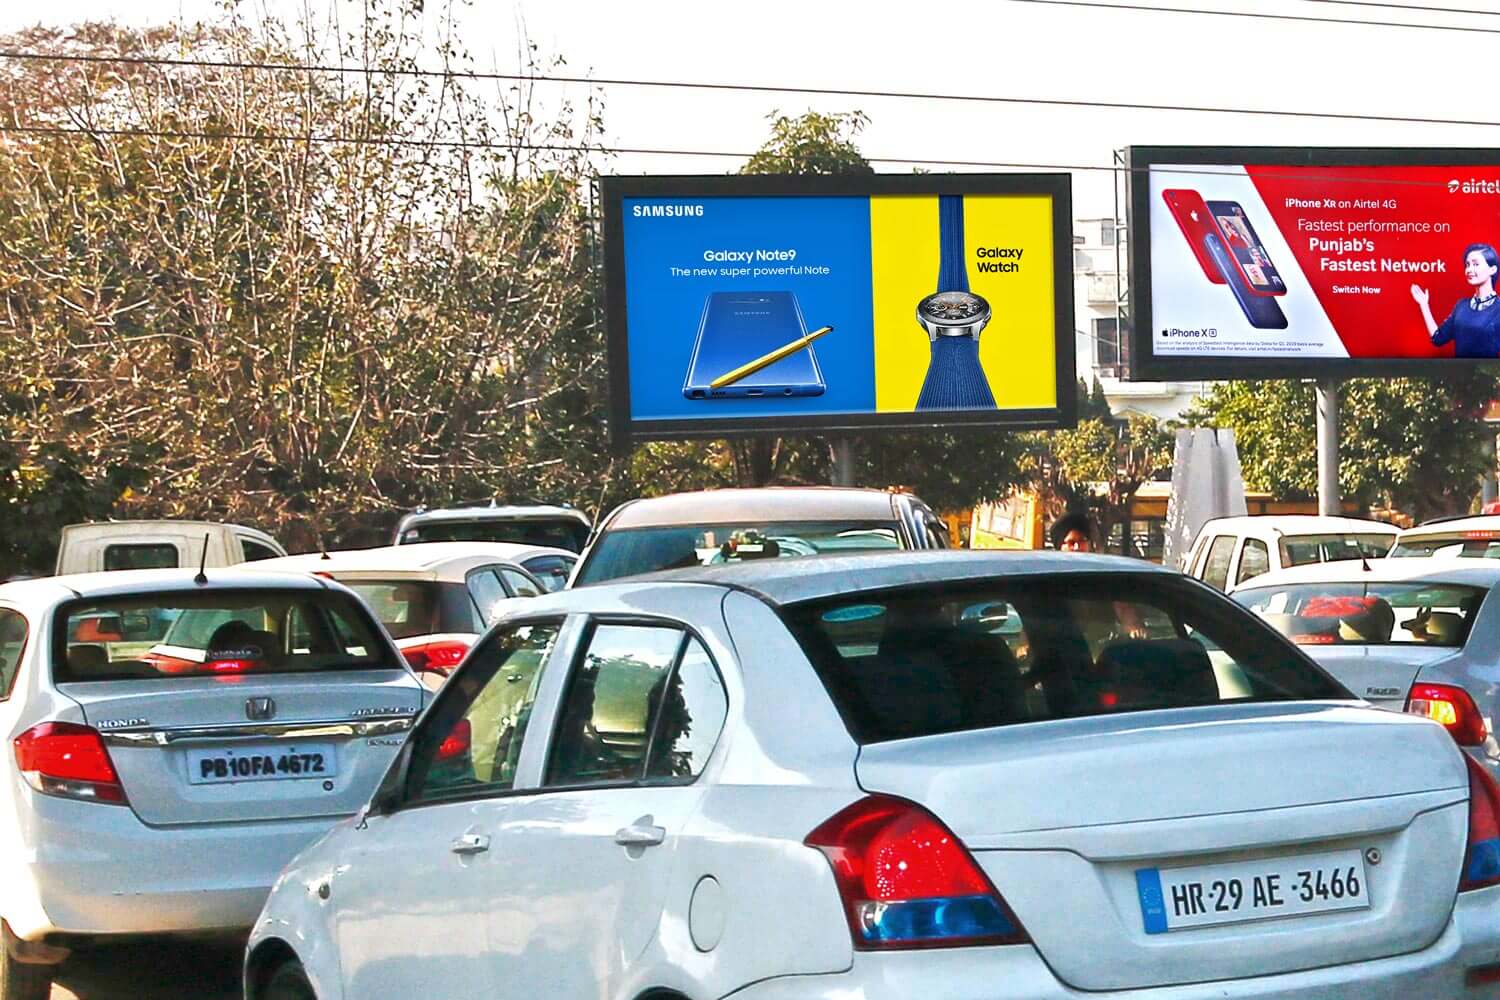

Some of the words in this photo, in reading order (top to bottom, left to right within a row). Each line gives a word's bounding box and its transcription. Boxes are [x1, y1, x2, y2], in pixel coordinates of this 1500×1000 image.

[1462, 179, 1500, 194] airtel
[1285, 198, 1321, 209] iPhone
[1338, 201, 1351, 209] on
[1353, 198, 1380, 209] Airtel
[1382, 199, 1397, 209] 4G
[633, 205, 704, 217] SAMSUNG
[1298, 218, 1344, 233] Fastest
[1347, 219, 1431, 236] performance
[1433, 223, 1450, 233] on
[703, 249, 754, 264] Galaxy
[756, 249, 797, 261] Note9
[976, 247, 1023, 260] Galaxy
[670, 267, 690, 277] The
[719, 268, 751, 278] super
[753, 265, 802, 278] powerful
[804, 265, 830, 276] Note
[977, 262, 1019, 273] Watch
[1320, 258, 1376, 272] Fastest
[1380, 258, 1446, 273] Network
[1332, 285, 1359, 294] Switch
[1361, 286, 1381, 294] Now
[1170, 328, 1199, 338] iPhone
[1253, 875, 1284, 908] AE
